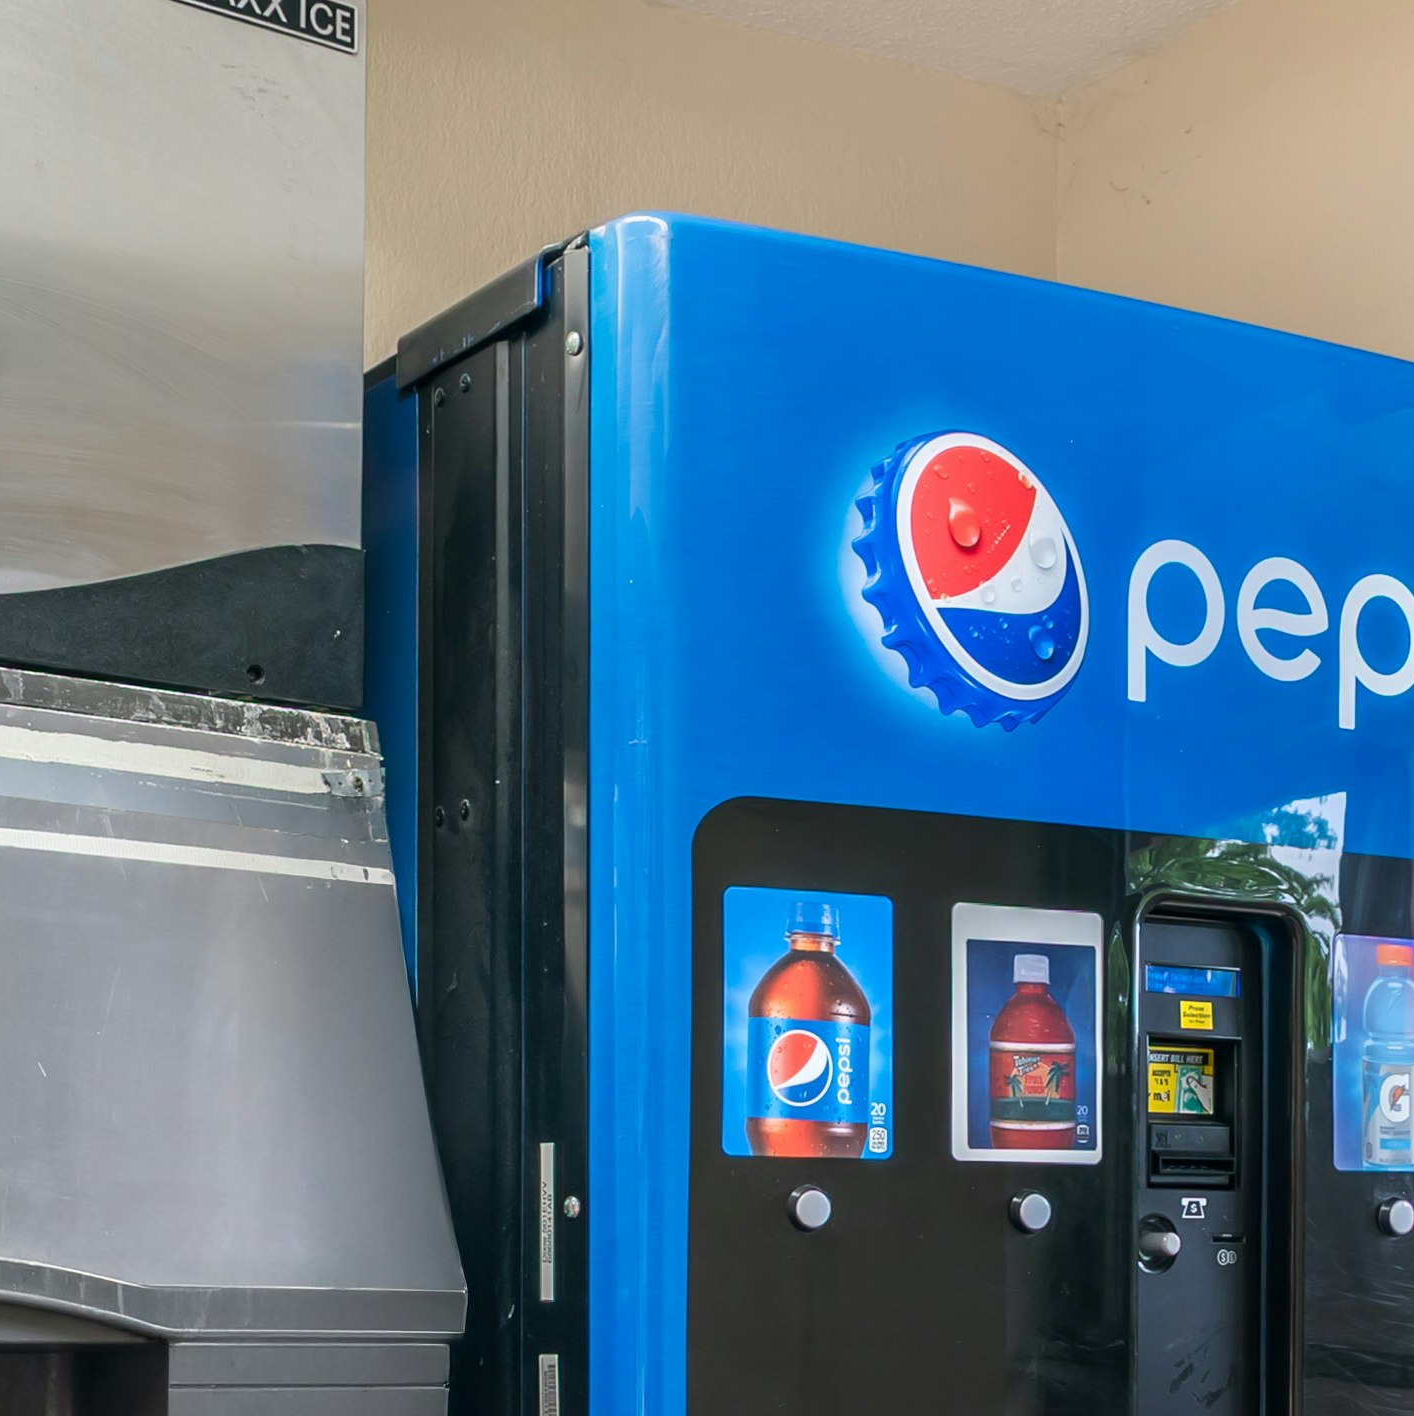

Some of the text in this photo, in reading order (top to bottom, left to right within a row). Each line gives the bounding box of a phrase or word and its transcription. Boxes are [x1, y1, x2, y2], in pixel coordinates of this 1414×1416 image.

[300, 0, 352, 43] ICE
[1148, 1053, 1169, 1063] NSERT
[835, 1037, 853, 1105] pepsi
[1379, 1073, 1410, 1123] G
[870, 1102, 886, 1116] 20
[1076, 1105, 1089, 1115] 20
[872, 1130, 886, 1140] 250
